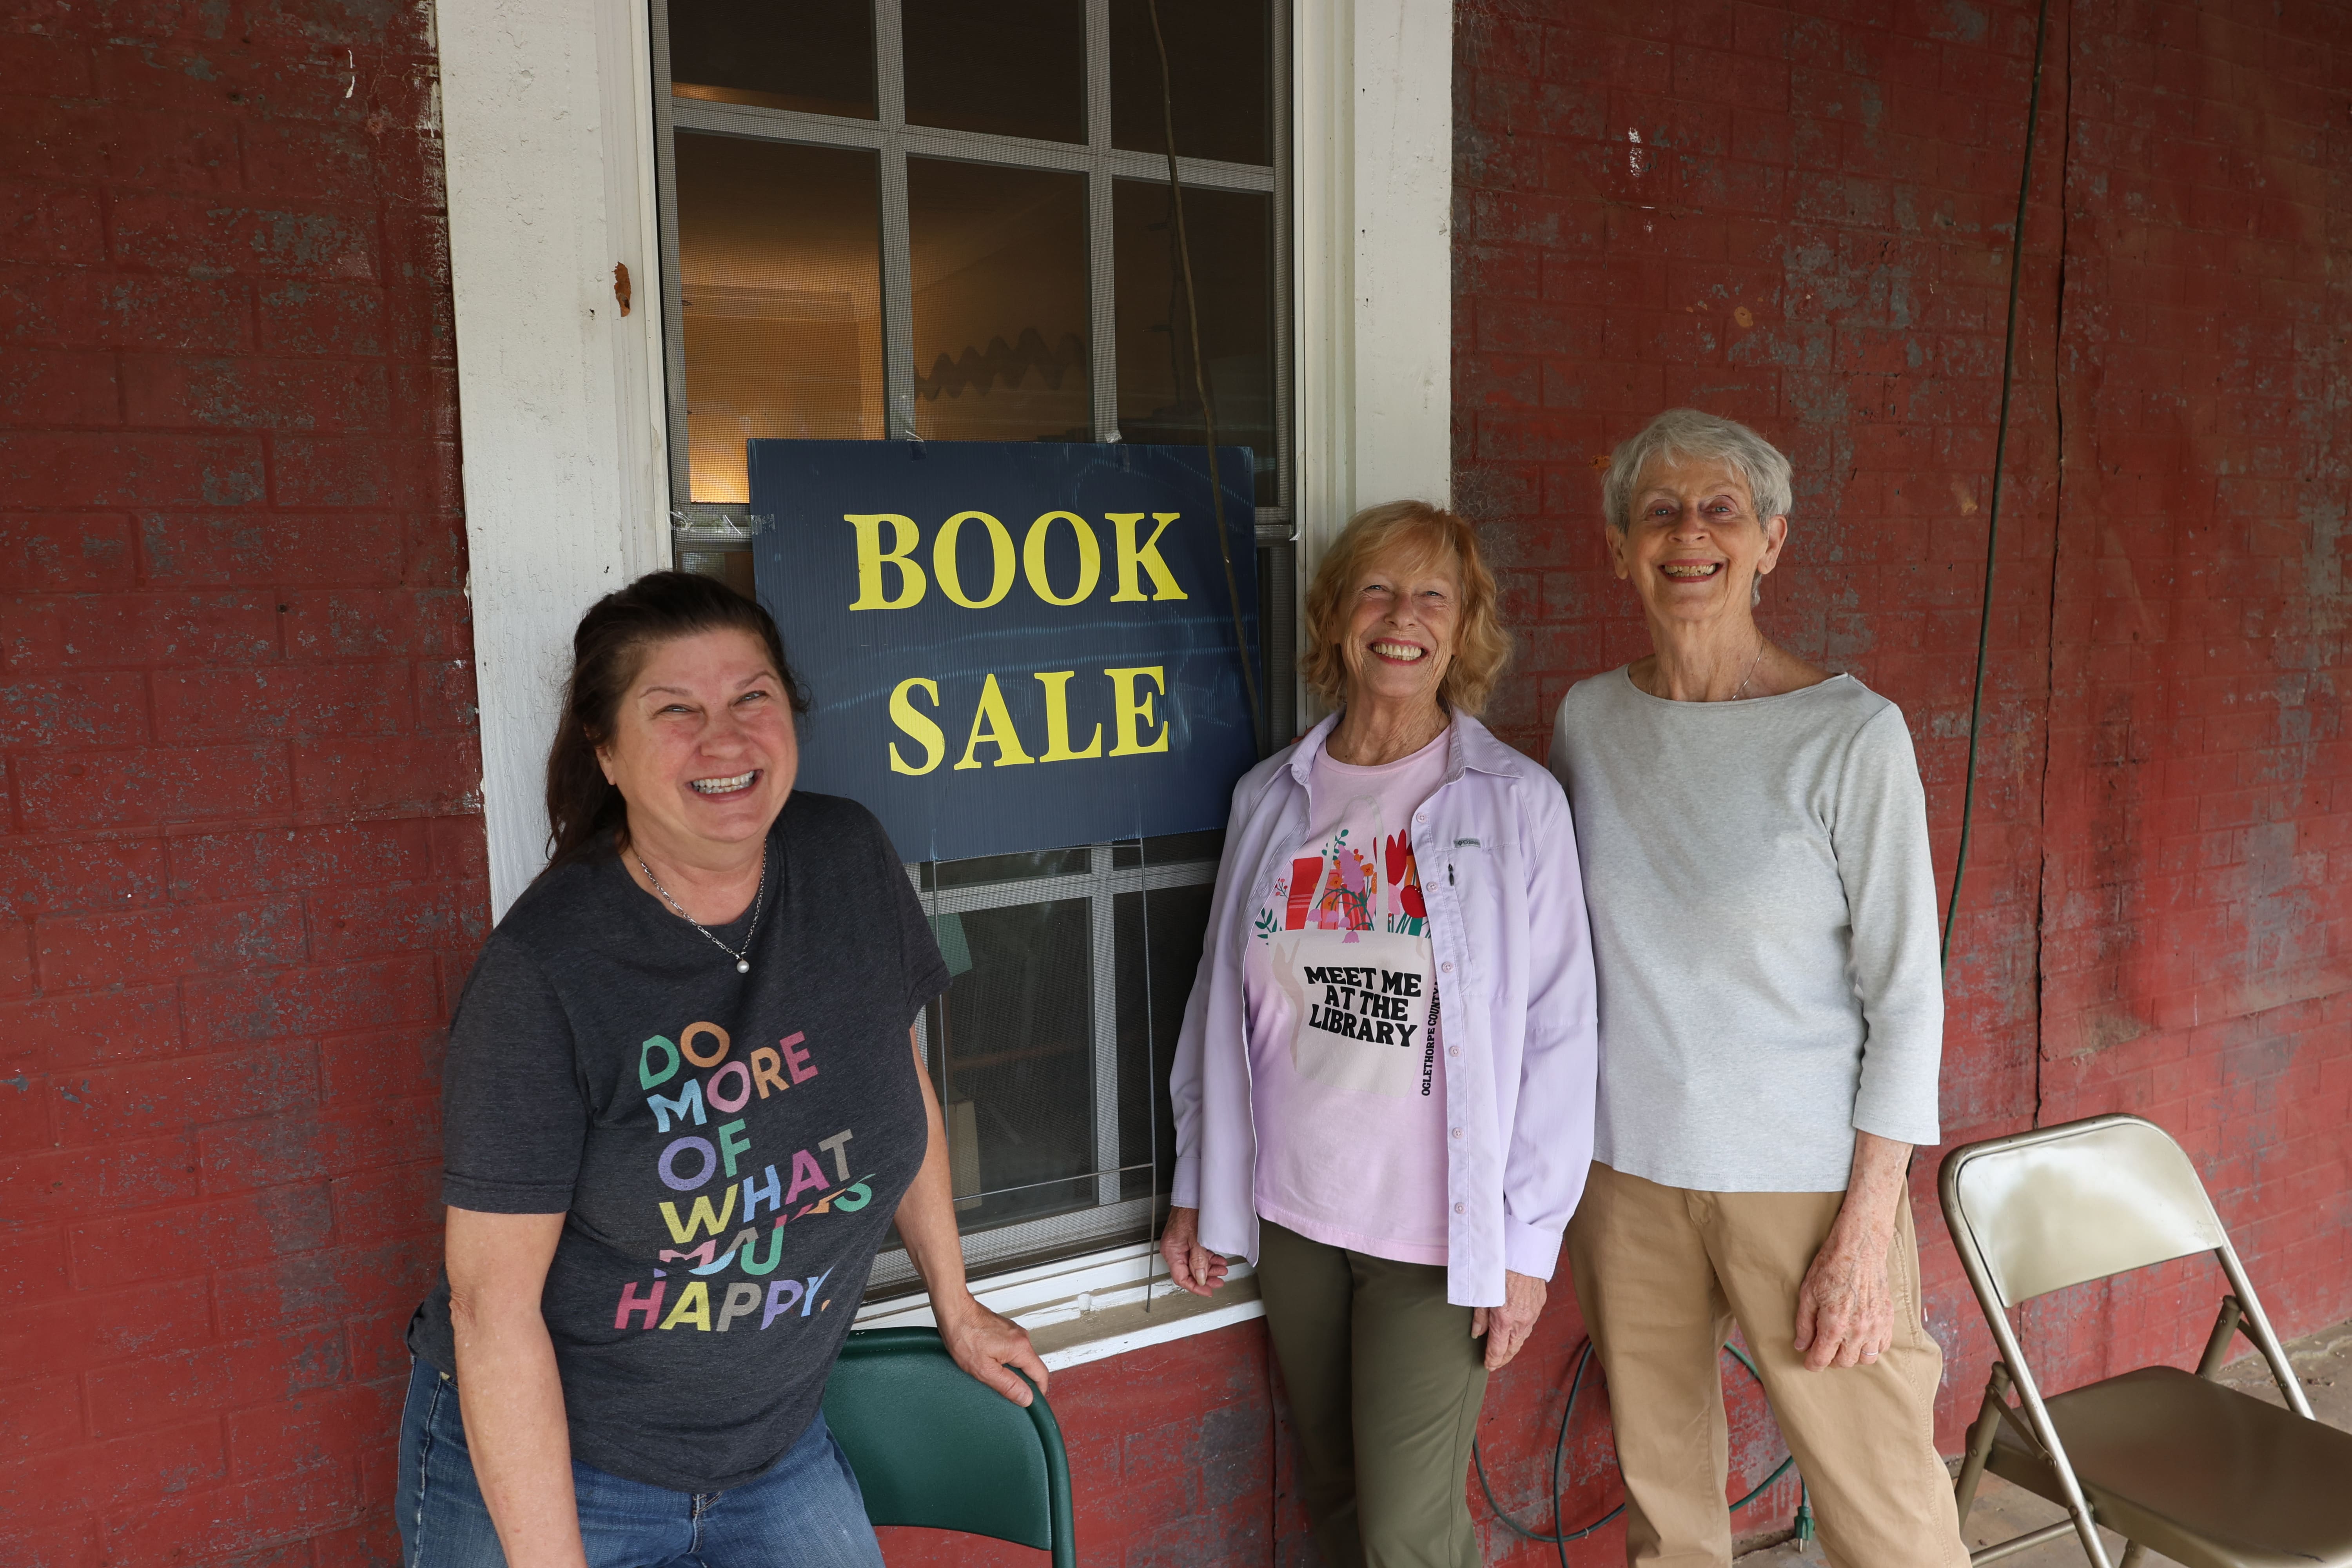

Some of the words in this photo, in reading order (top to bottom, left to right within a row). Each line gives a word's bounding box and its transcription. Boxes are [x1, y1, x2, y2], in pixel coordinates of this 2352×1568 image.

[844, 511, 1188, 611] BOOK
[889, 666, 1168, 775] SALE
[1304, 966, 1377, 989] MEET
[1381, 969, 1421, 997] ME
[1325, 985, 1363, 1010] AT
[1360, 990, 1408, 1021] THE
[1428, 987, 1440, 1026] COUNTY
[639, 1021, 730, 1090] DO
[1309, 1004, 1418, 1047] LIBRARY
[647, 1031, 818, 1133] MORE
[1422, 1027, 1435, 1096] OGLETHORPE
[658, 1118, 751, 1191] OF
[659, 1129, 853, 1244] WHAT
